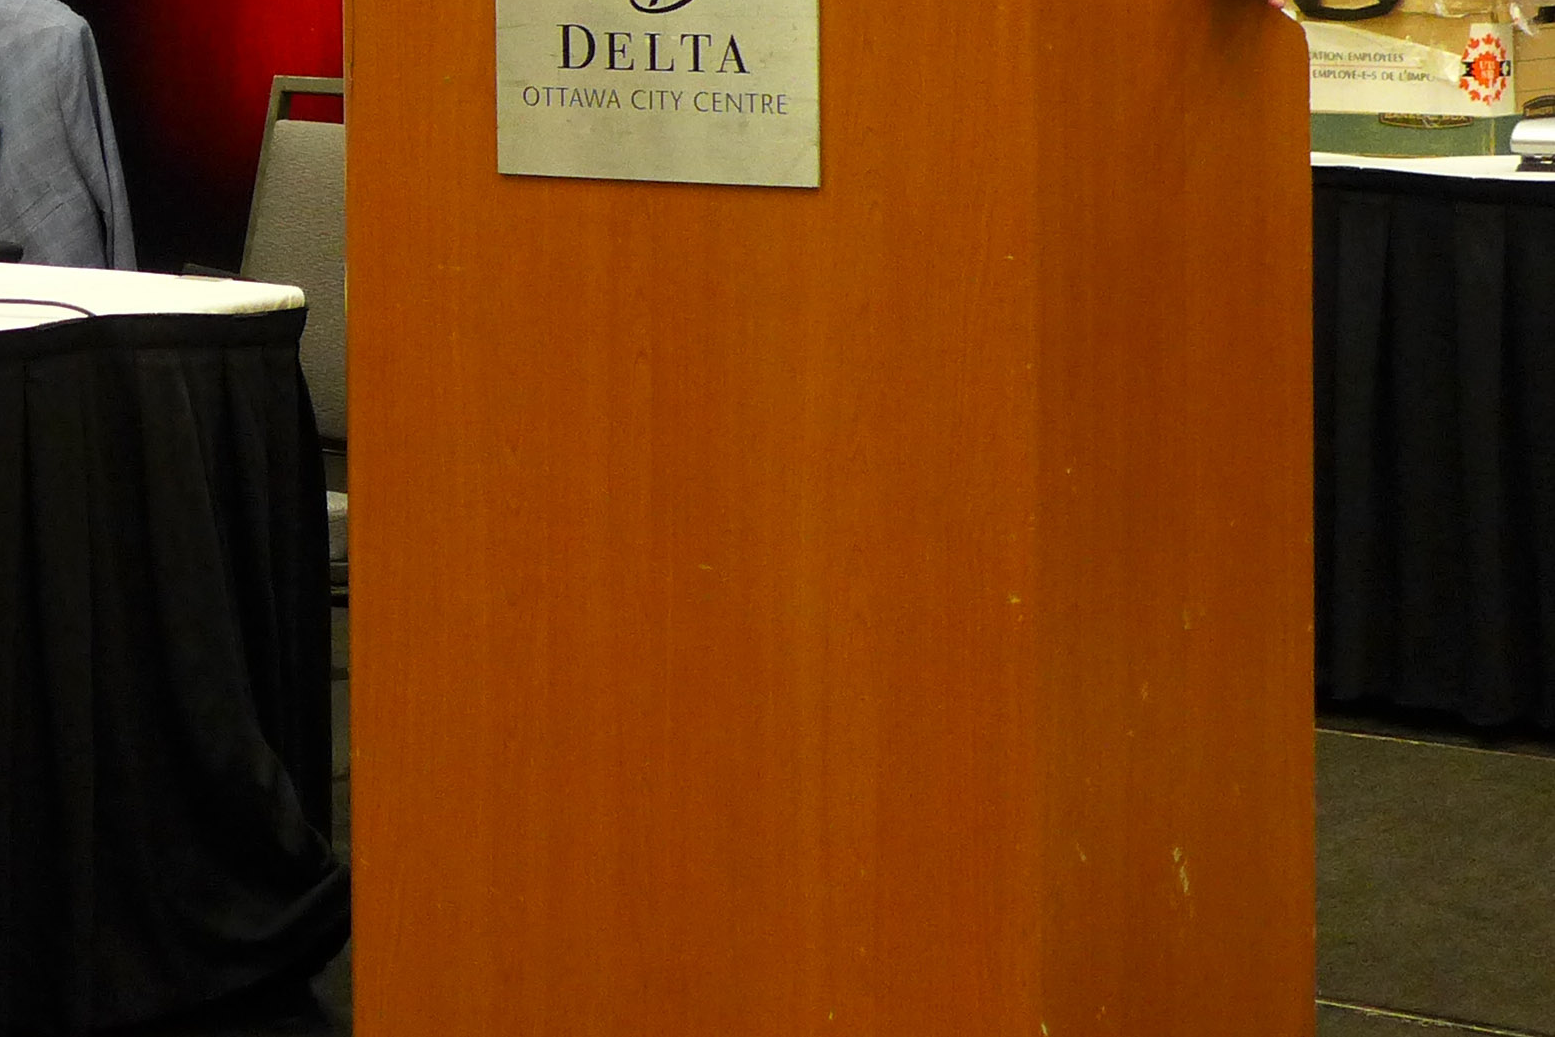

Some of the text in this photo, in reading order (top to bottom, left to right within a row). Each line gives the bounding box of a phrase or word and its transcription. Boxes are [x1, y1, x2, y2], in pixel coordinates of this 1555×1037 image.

[555, 23, 751, 74] DELTA
[1348, 51, 1405, 62] EMPLOYEES
[1381, 71, 1394, 81] DE
[522, 85, 789, 115] OTTAWA CITY CENTRE
